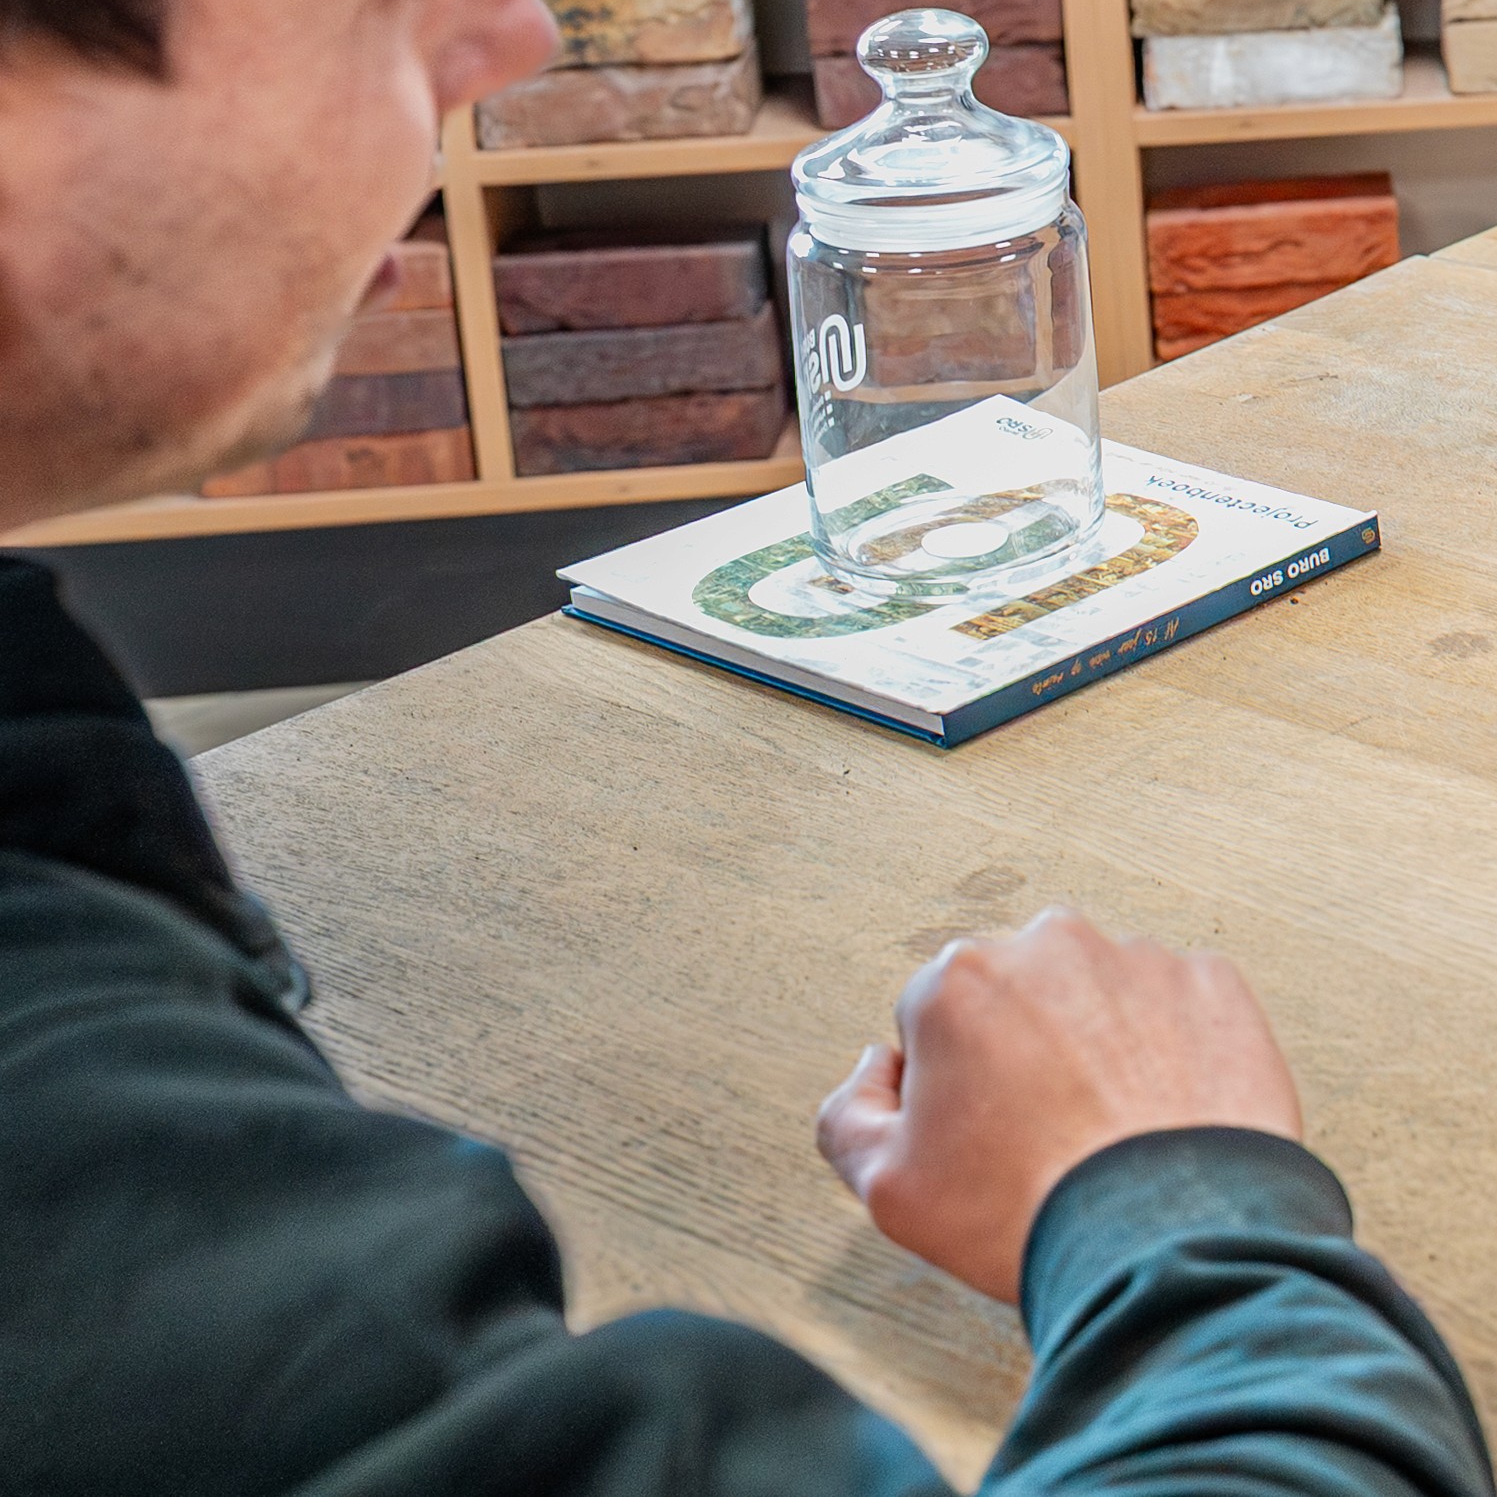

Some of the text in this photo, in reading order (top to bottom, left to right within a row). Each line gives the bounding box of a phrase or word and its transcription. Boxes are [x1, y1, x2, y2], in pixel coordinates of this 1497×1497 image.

[1144, 474, 1317, 529] Projectenboek
[1249, 546, 1330, 595] BURO SRO
